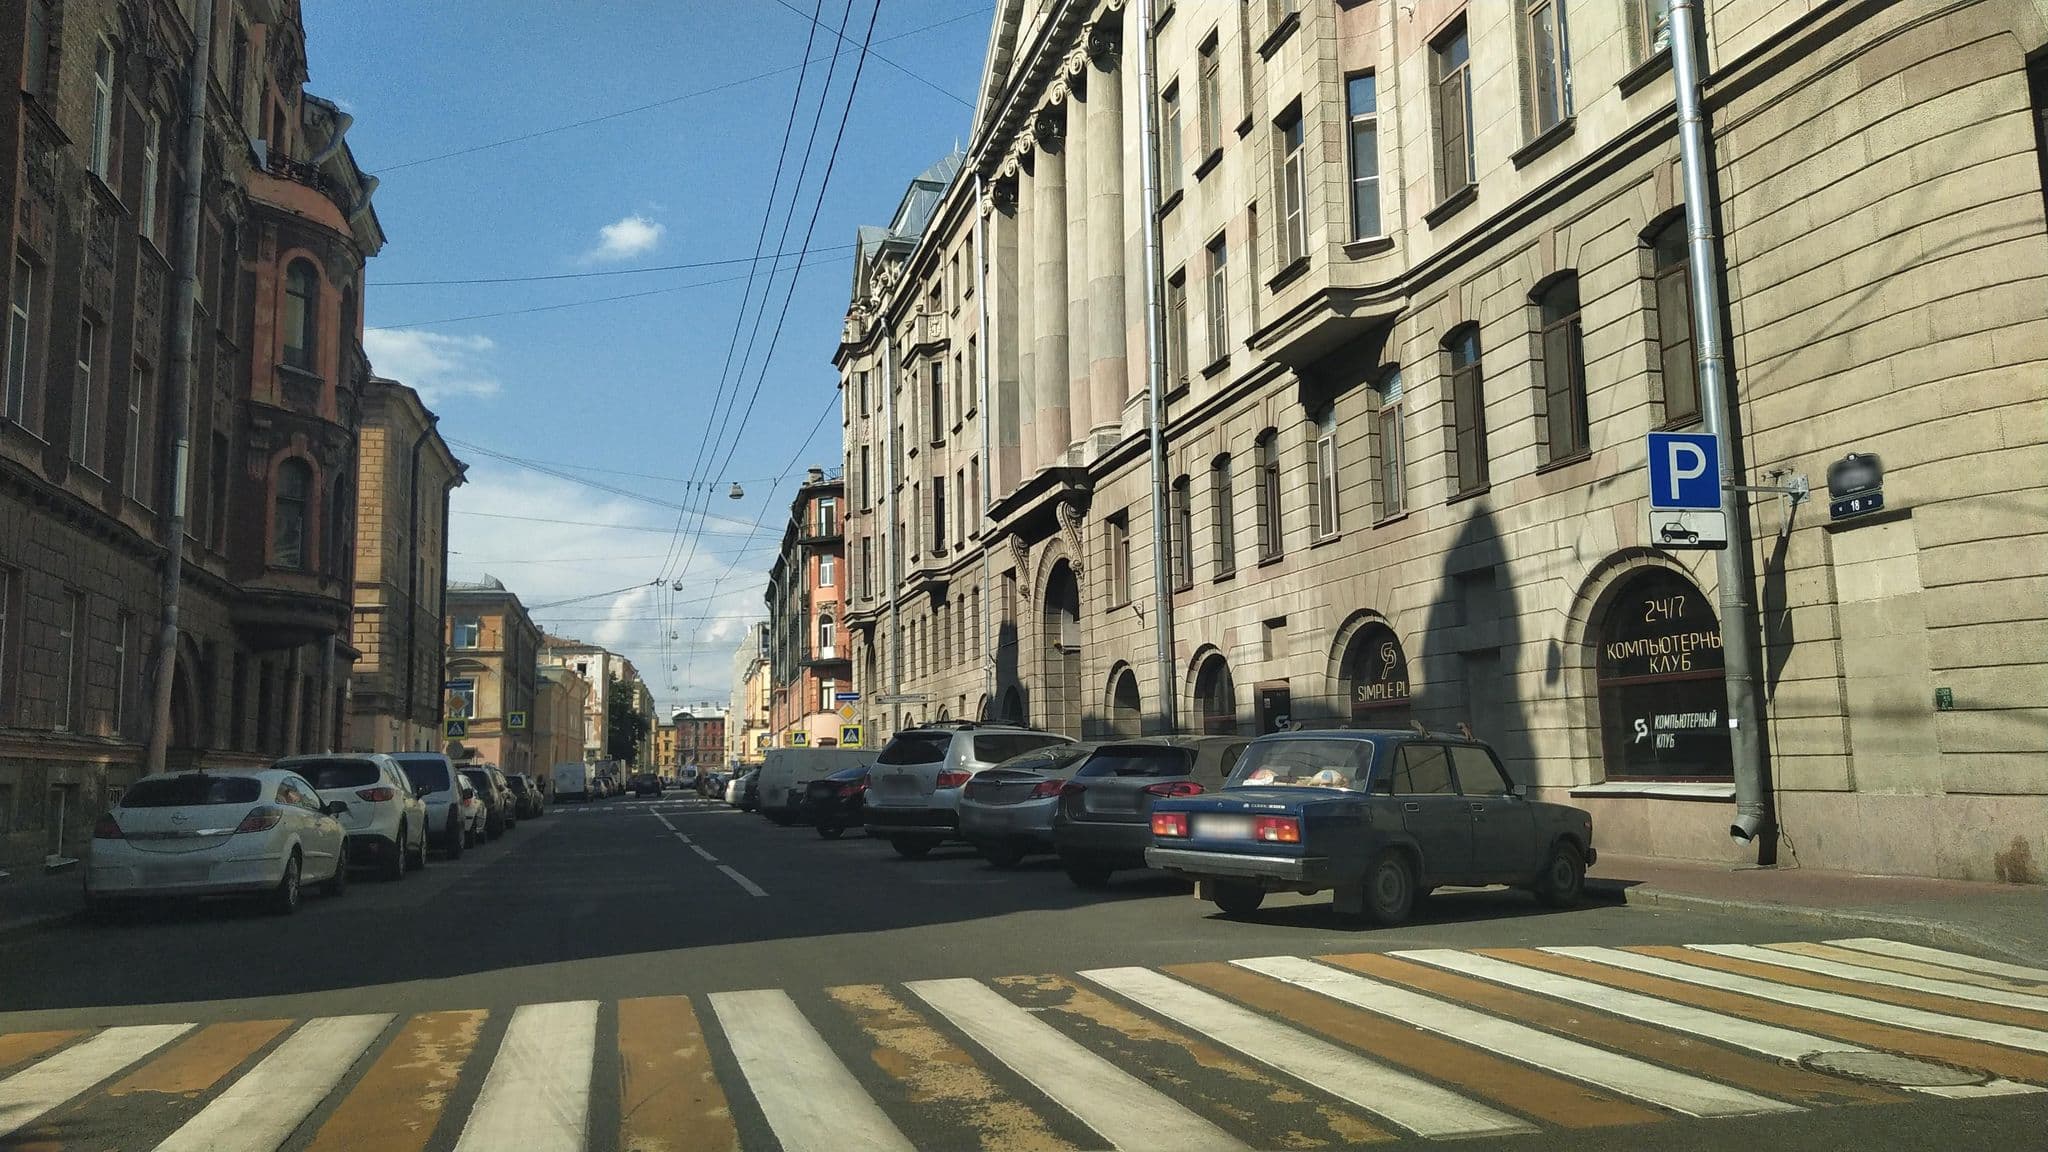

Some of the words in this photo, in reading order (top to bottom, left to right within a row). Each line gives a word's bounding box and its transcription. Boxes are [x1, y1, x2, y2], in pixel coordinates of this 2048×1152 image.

[1668, 442, 1706, 499] P
[1645, 596, 1685, 622] 24/7
[1650, 653, 1691, 673] КЛУБ
[1358, 683, 1394, 701] SIMPLE
[1654, 709, 1717, 729] КОМПЬЮТЕРНЫЙ
[1656, 733, 1675, 748] КЛУБ
